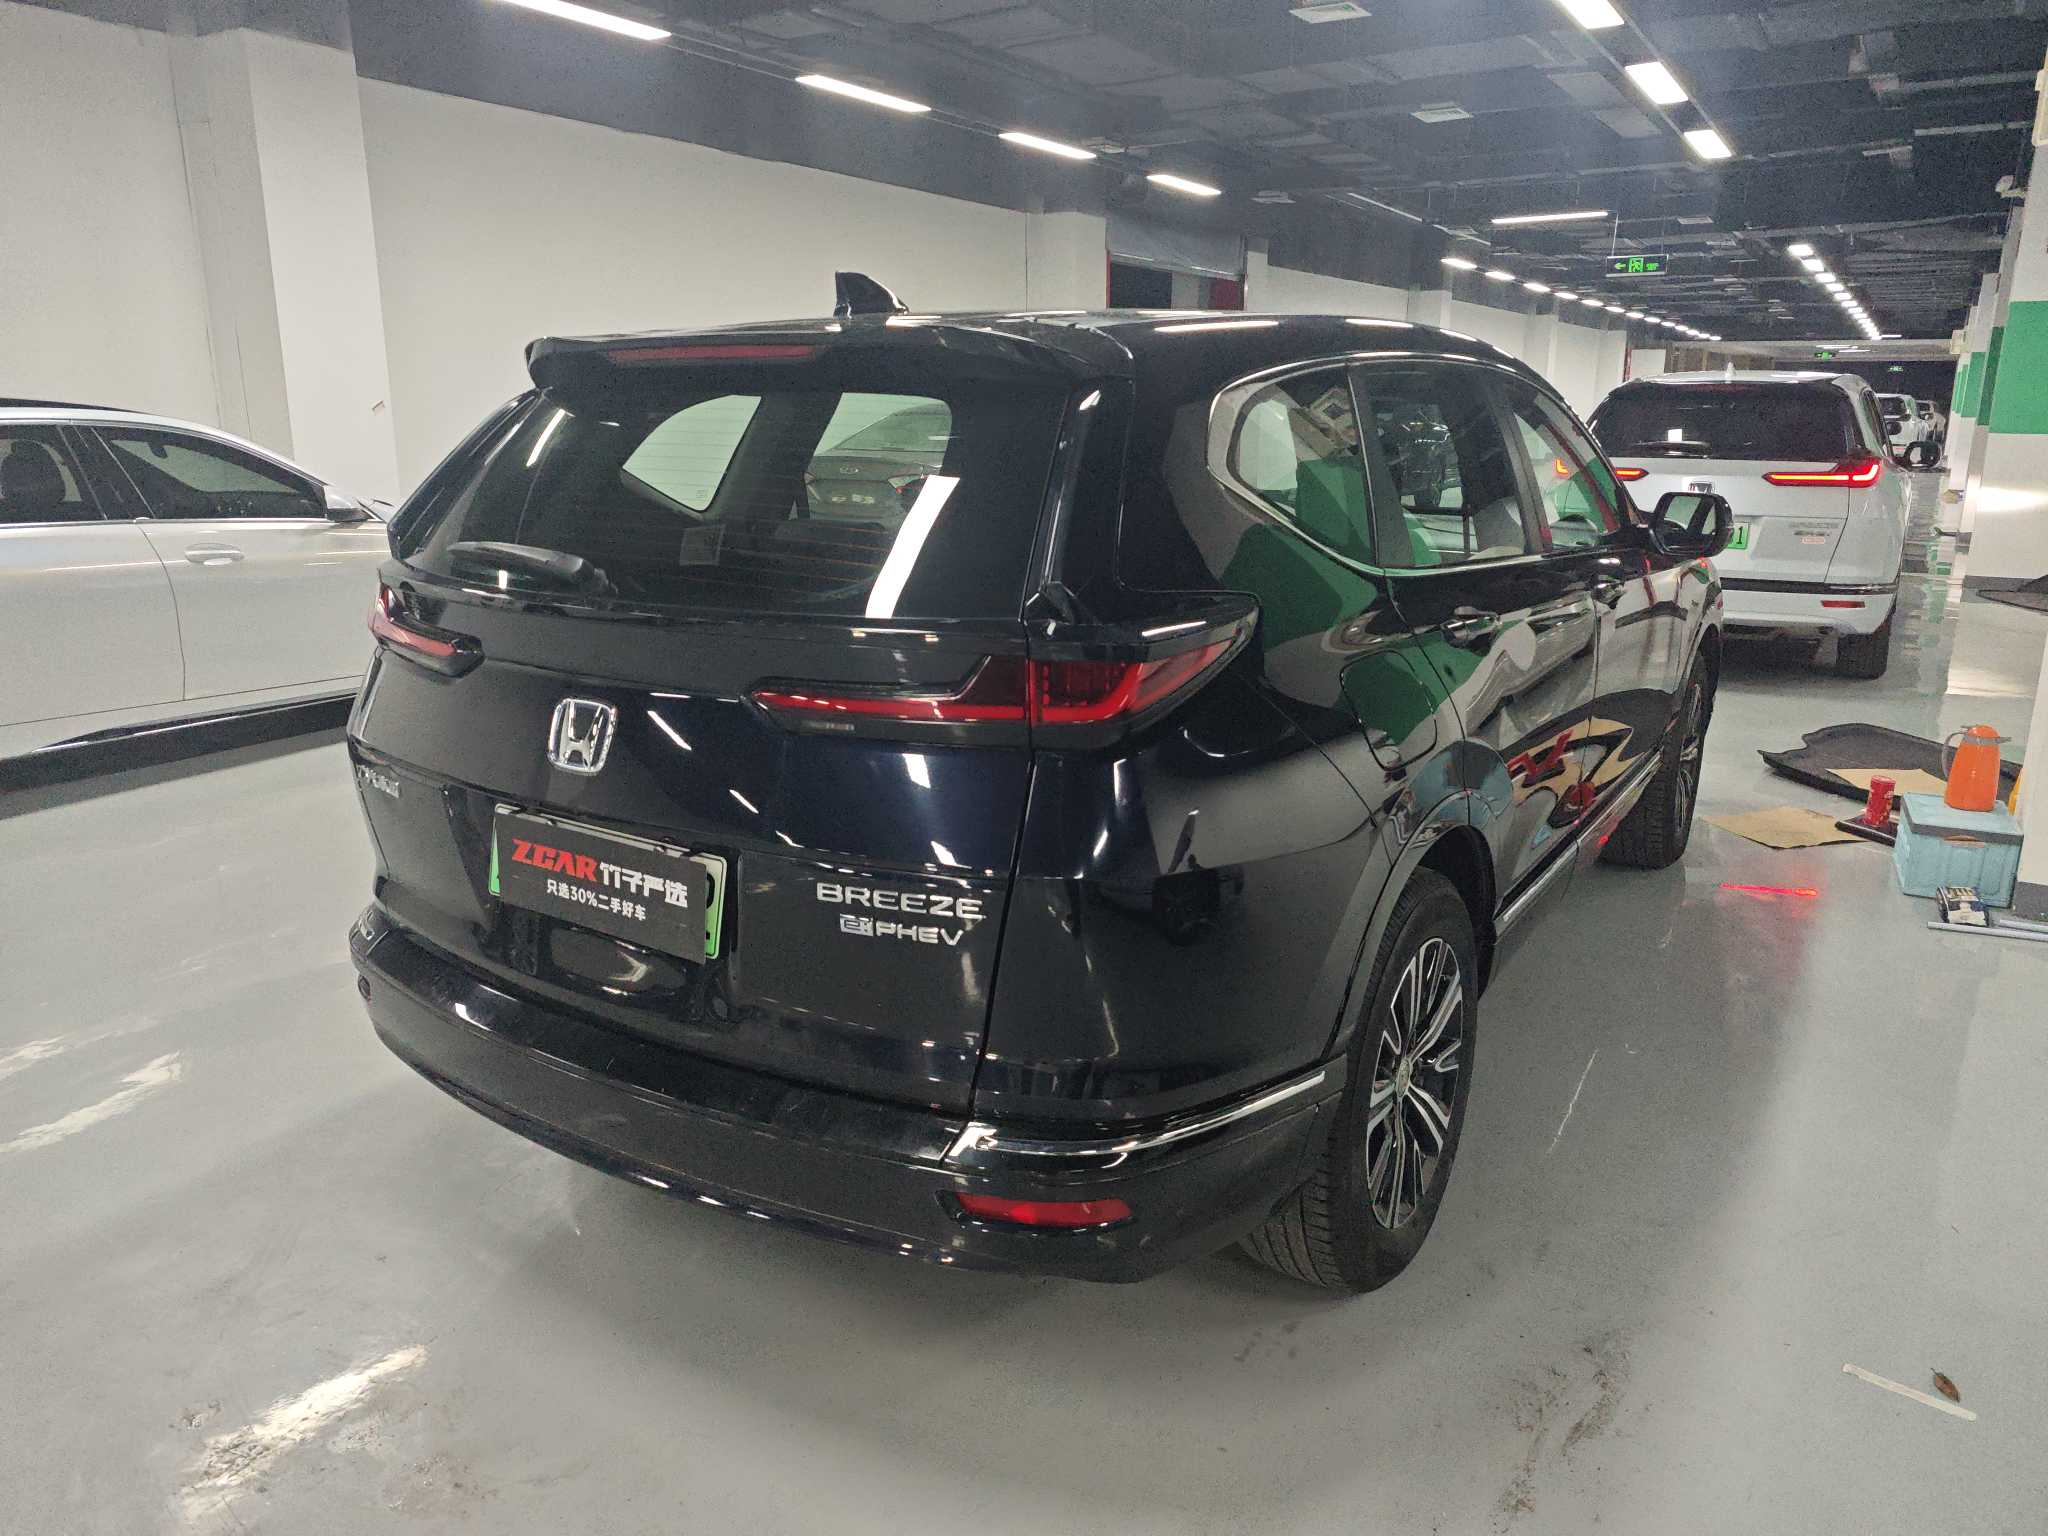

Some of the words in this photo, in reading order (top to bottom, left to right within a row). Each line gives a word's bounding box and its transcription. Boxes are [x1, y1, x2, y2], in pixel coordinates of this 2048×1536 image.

[512, 838, 600, 882] ZCAR
[600, 861, 688, 908] 竹子严选
[547, 879, 647, 921] 只选30%二手好车
[816, 882, 986, 919] BREEZE
